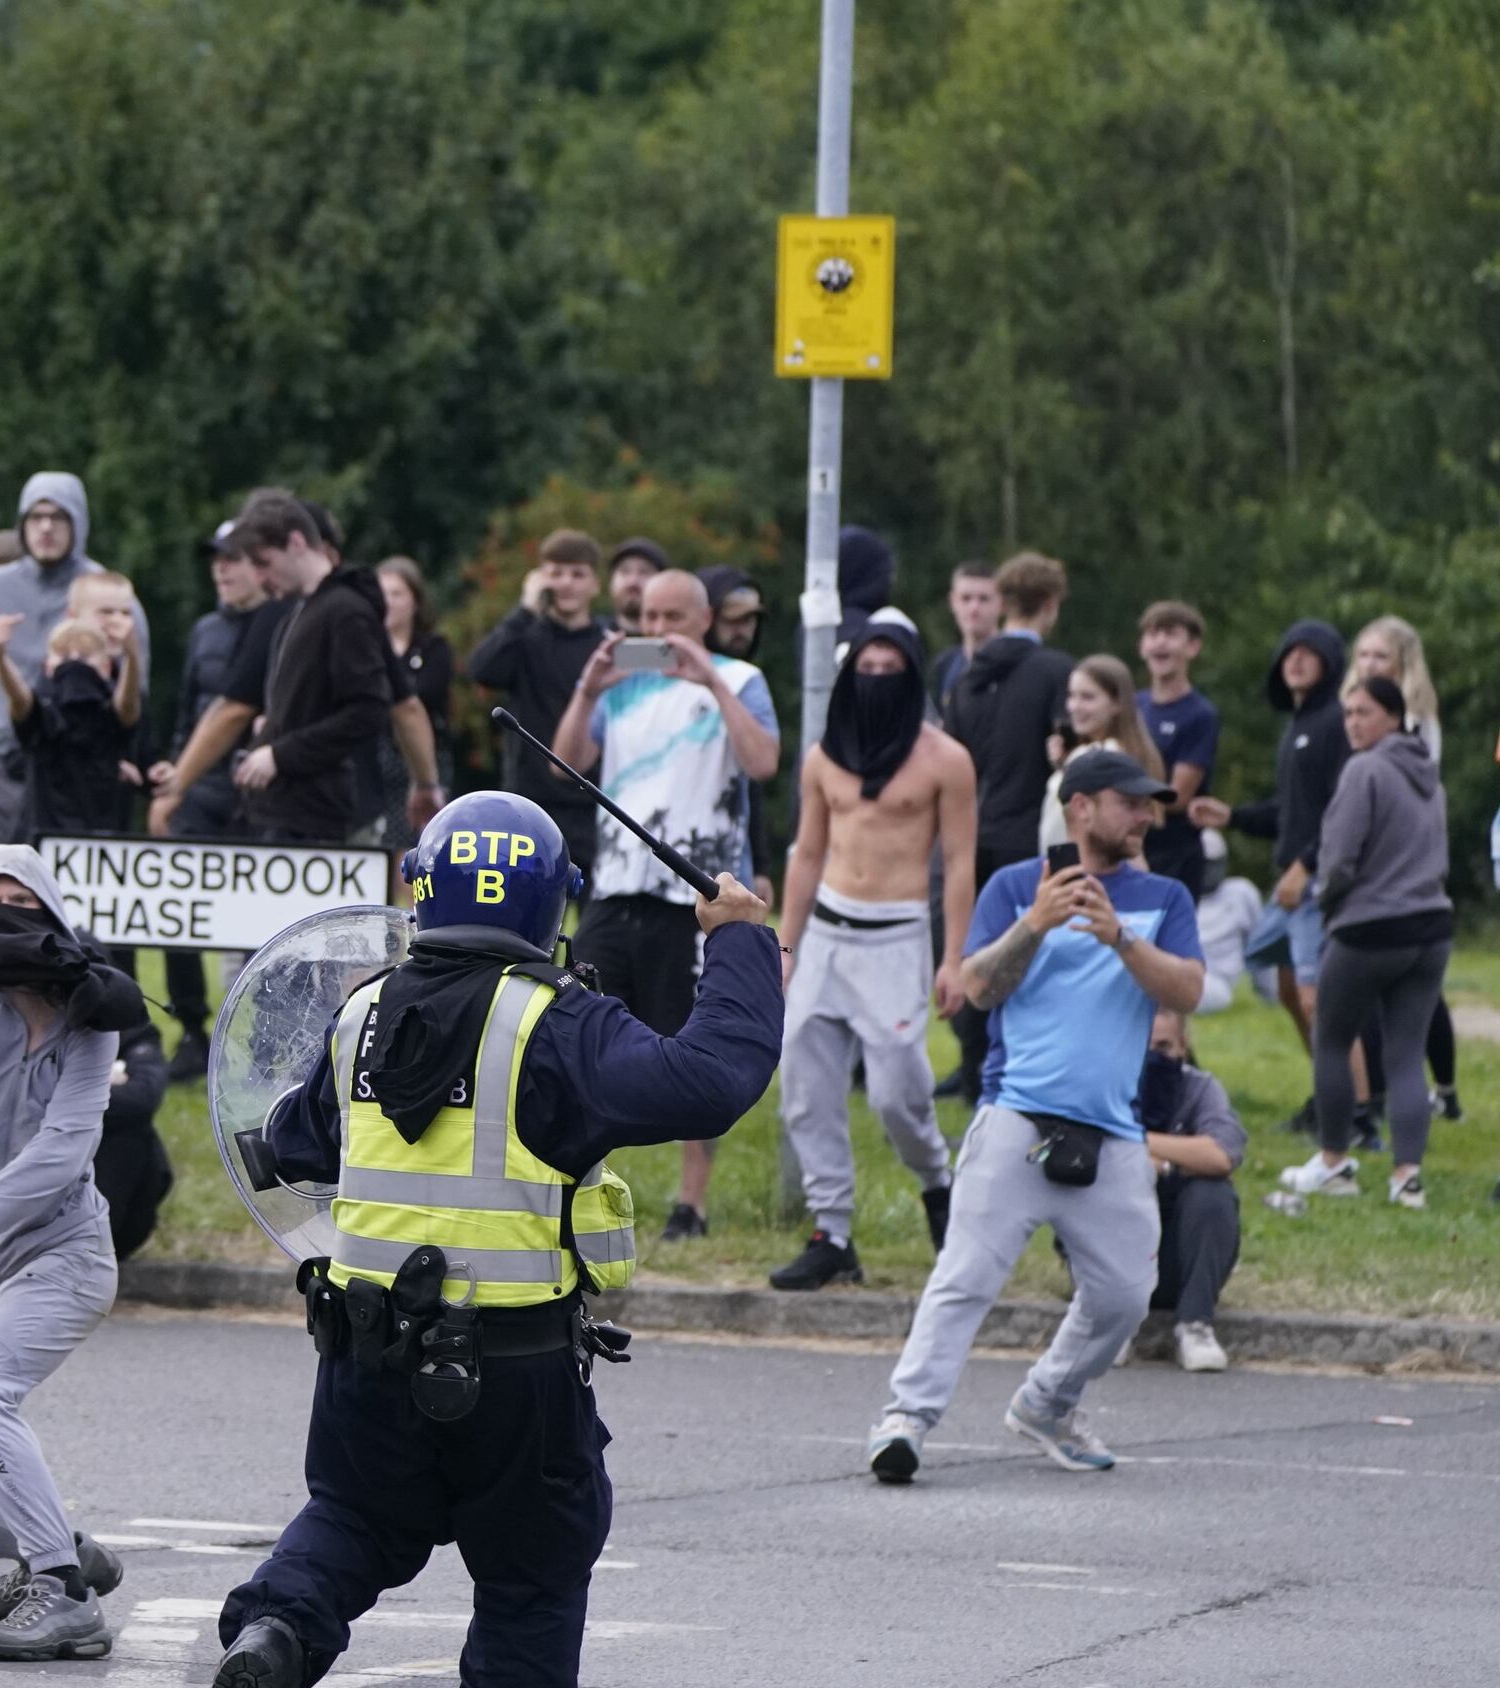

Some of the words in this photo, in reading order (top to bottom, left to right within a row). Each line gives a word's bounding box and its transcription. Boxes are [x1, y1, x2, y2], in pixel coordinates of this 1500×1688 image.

[450, 830, 536, 867] BTP
[53, 844, 366, 898] KINGSBROOK
[475, 868, 506, 904] B
